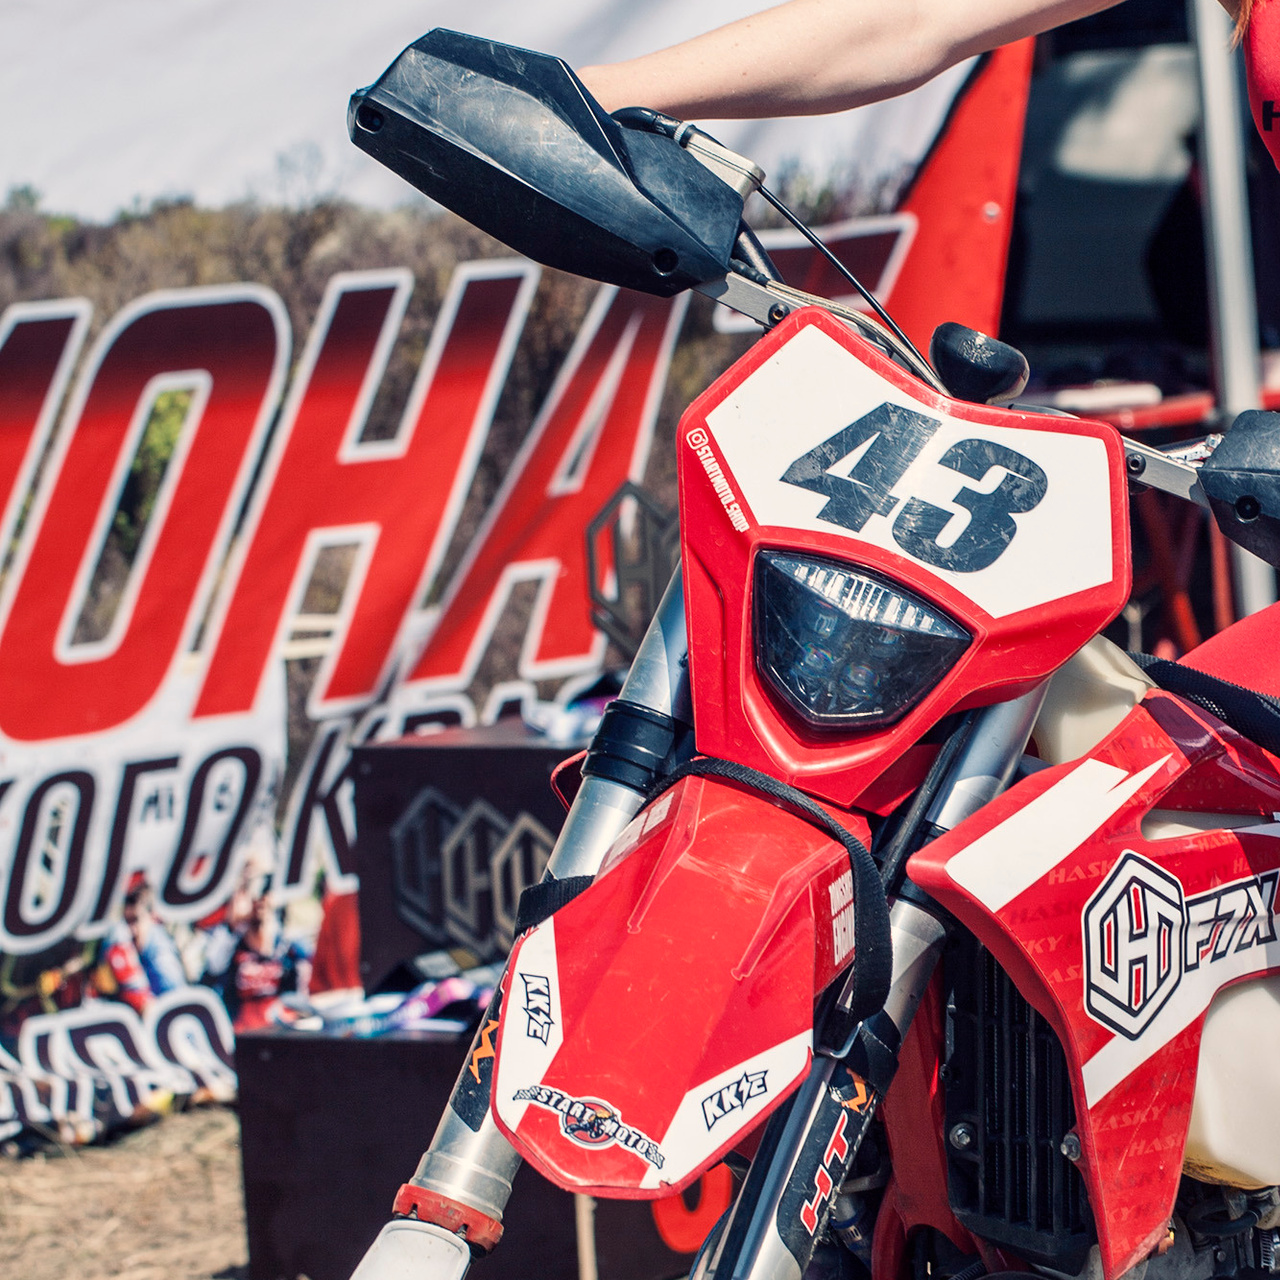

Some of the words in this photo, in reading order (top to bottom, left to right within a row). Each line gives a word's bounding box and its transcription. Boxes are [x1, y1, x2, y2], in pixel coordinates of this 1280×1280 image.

[696, 445, 750, 533] STARTMOTO.SHOP
[779, 401, 1048, 573] 43
[537, 1089, 596, 1122] START
[601, 1119, 650, 1153] MOTO
